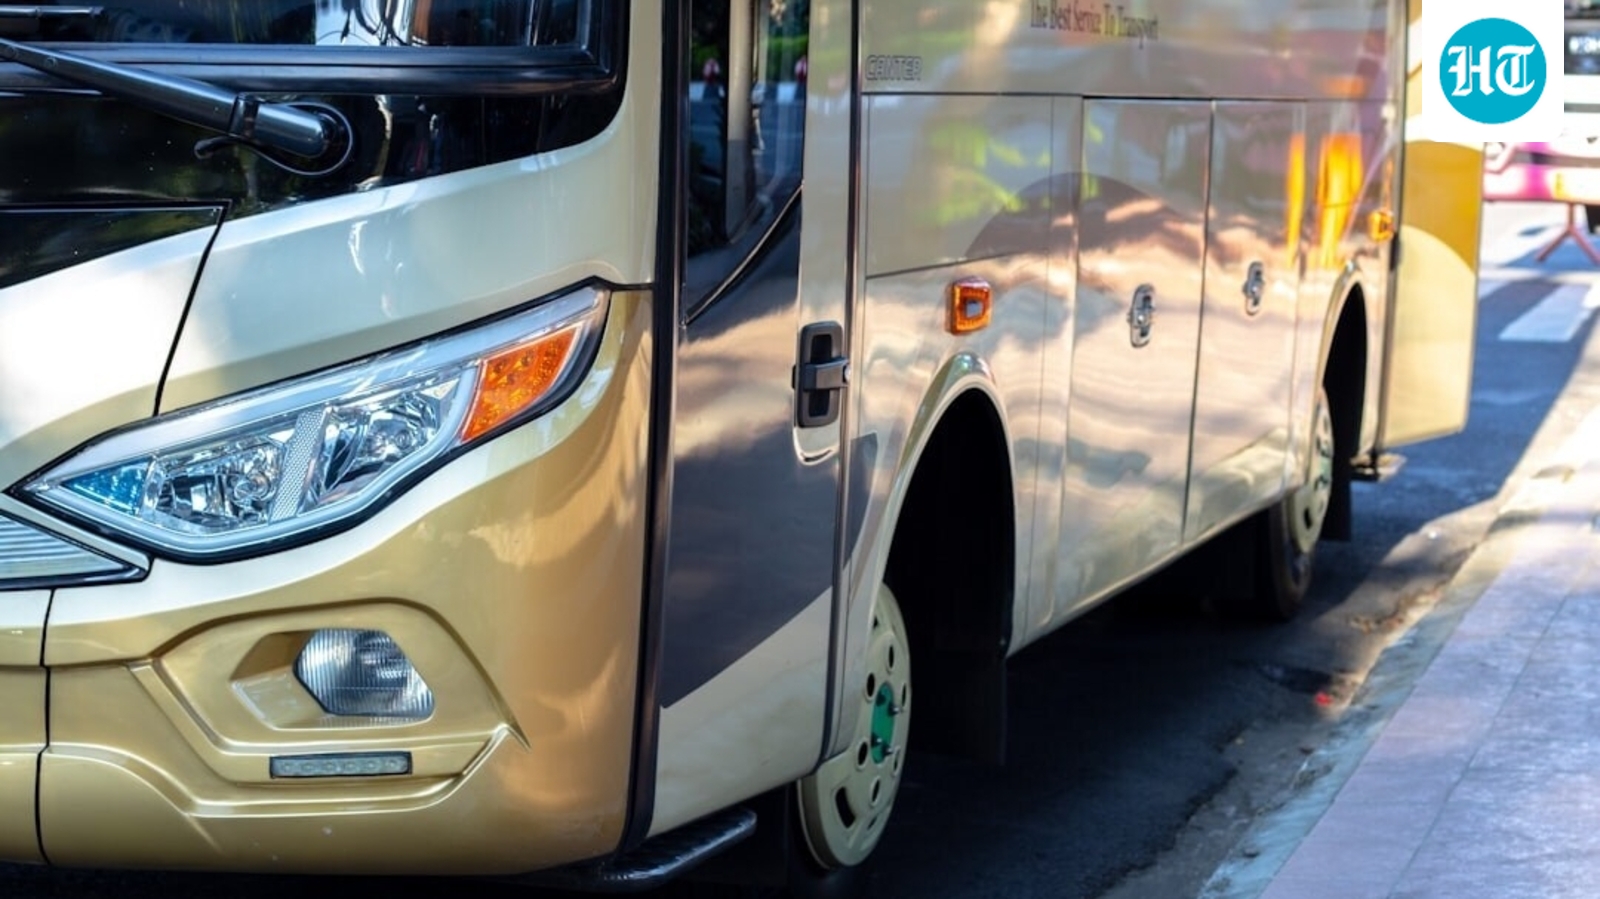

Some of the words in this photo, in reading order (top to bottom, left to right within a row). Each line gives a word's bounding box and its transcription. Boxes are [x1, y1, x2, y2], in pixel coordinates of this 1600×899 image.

[1050, 0, 1071, 31] Best
[1073, 0, 1101, 34] Service
[1102, 3, 1115, 36] To
[1116, 5, 1159, 49] Transport
[865, 55, 922, 81] CANTER
